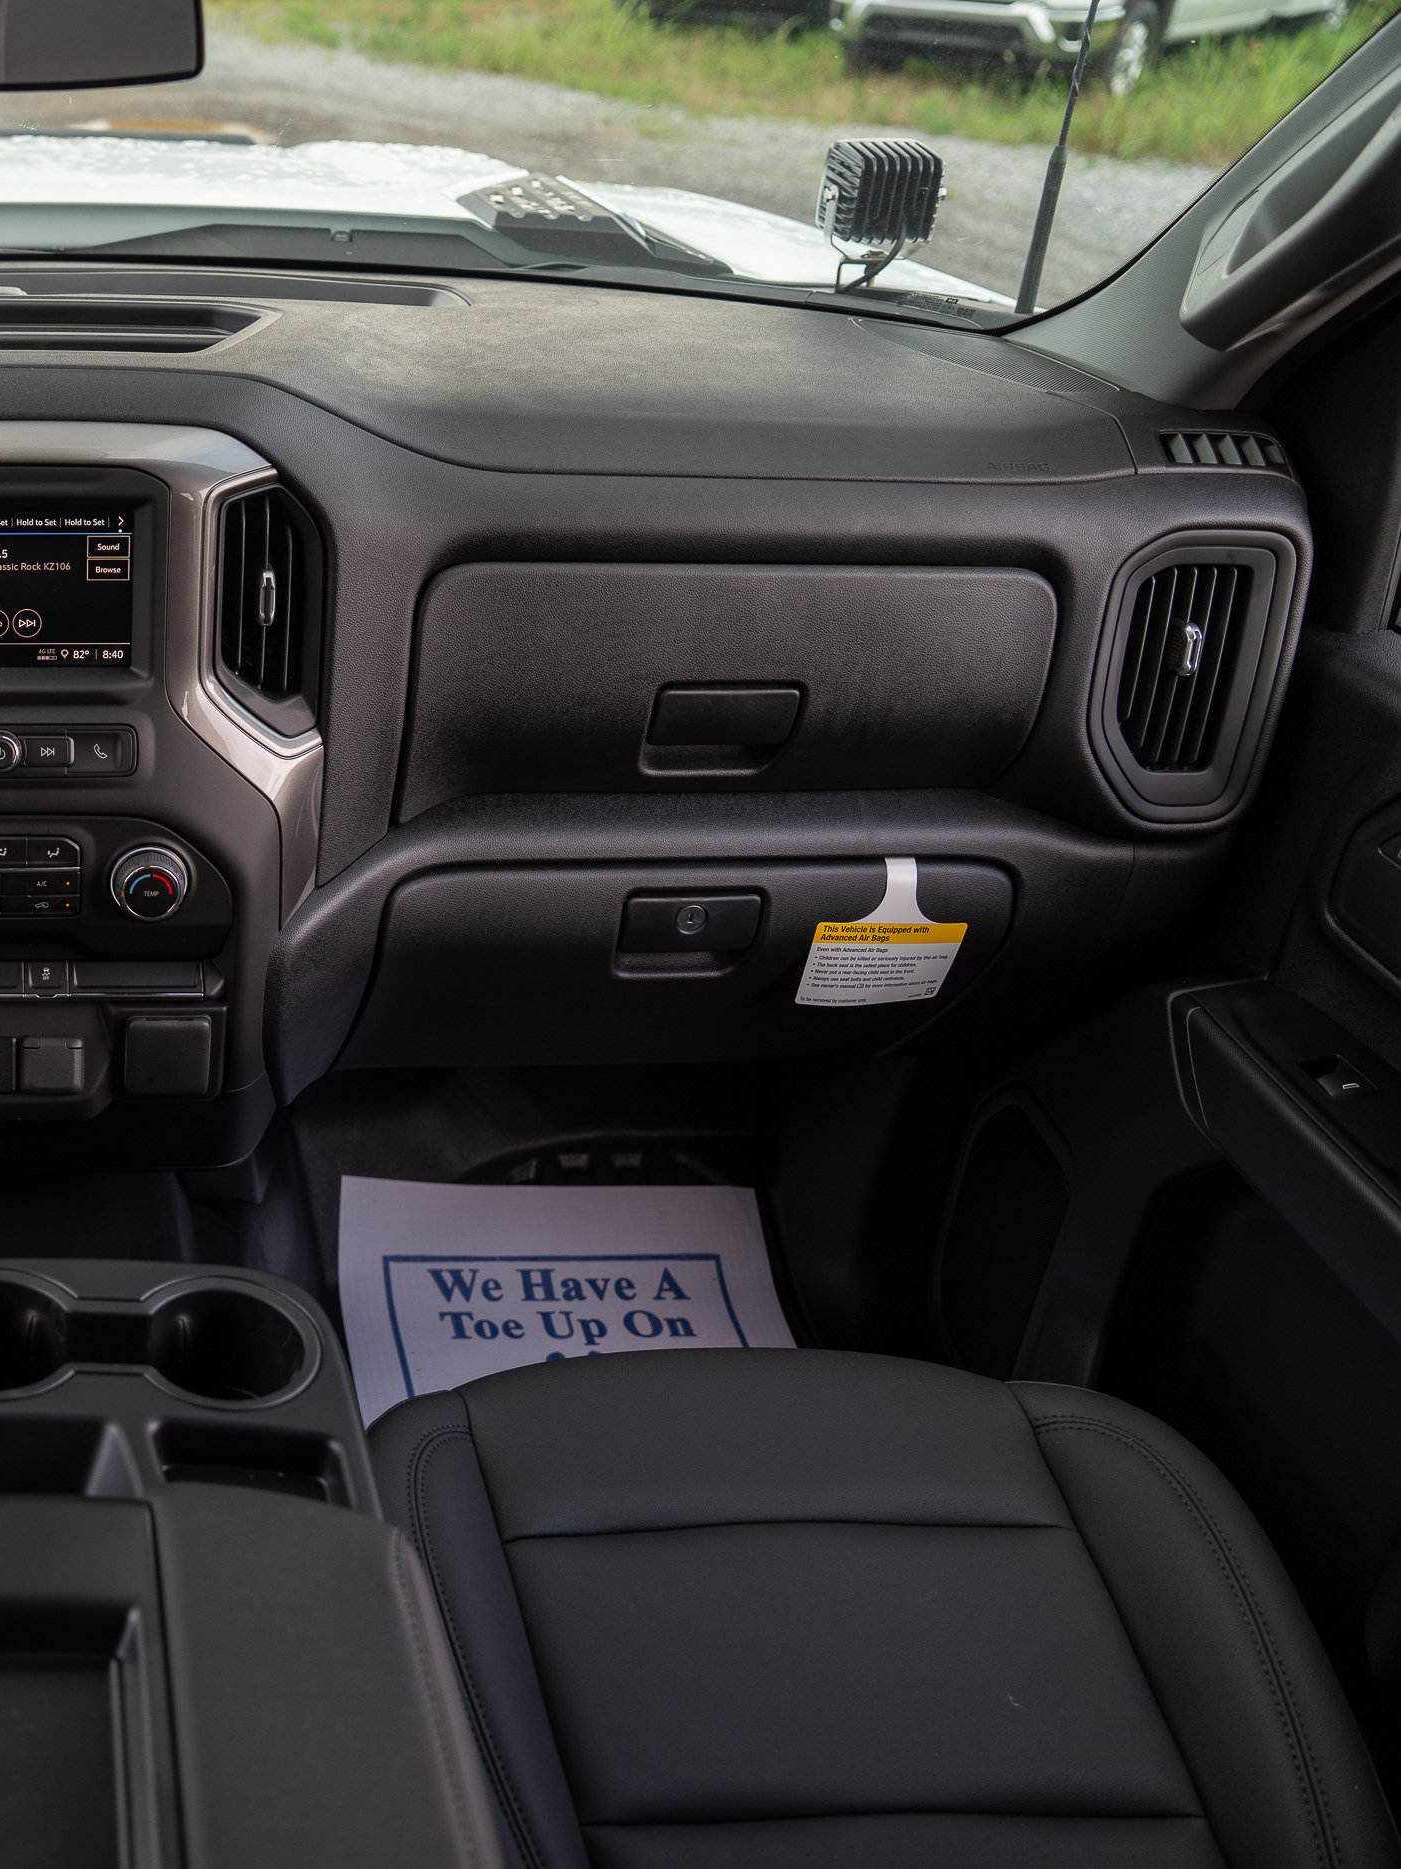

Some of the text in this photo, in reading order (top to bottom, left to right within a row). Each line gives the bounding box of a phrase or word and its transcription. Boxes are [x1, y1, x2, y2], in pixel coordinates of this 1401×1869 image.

[988, 462, 1050, 472] AIRBAG
[16, 519, 34, 527] Hold
[44, 519, 56, 527] Set
[64, 519, 82, 527] Hold
[92, 519, 105, 527] Set
[97, 543, 120, 551] Sound
[20, 562, 41, 571] Rock
[43, 562, 71, 571] KZ106
[95, 566, 121, 574] Browse
[73, 649, 89, 659] 82°
[102, 649, 124, 659] 8:40
[36, 880, 48, 888] A/C
[823, 925, 839, 933] This
[840, 925, 868, 933] Vehicle
[878, 926, 911, 935] Equipped
[913, 926, 929, 934] with
[820, 934, 890, 943] Advanced Air Bags
[427, 1265, 691, 1303] We Have A
[439, 1309, 697, 1345] Toe Up On
